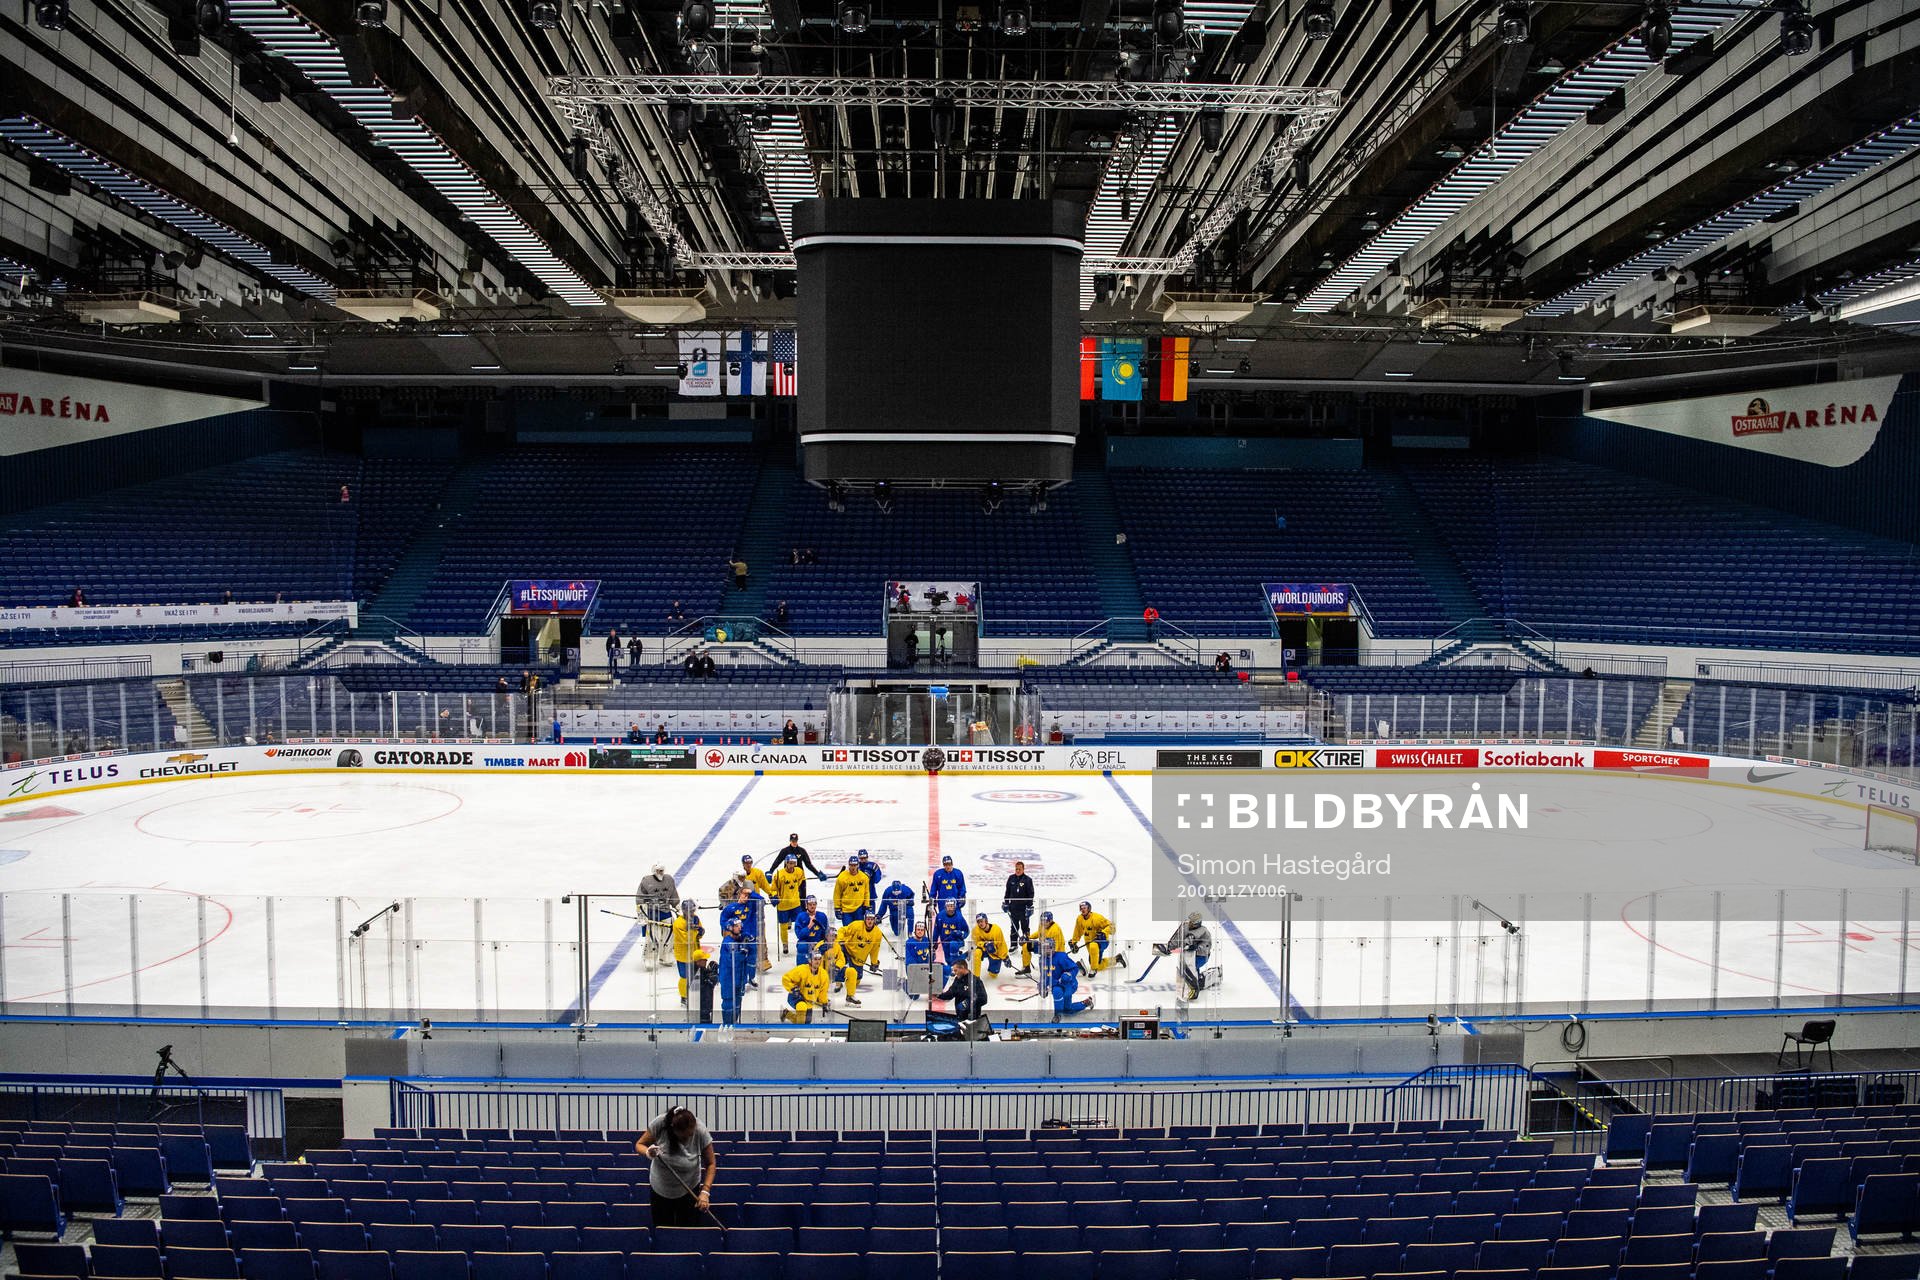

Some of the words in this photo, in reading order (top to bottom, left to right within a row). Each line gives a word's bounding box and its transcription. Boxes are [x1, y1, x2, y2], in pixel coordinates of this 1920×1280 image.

[19, 396, 110, 423] ARÉNA
[1735, 415, 1779, 432] OSTRAVAR
[1786, 403, 1878, 429] ARÉNA
[521, 589, 588, 601] #LETSSHOWOFF
[1271, 592, 1344, 604] #WORLDJUNIORS
[374, 751, 473, 765] GATORADE
[484, 758, 524, 766] TIMBER
[528, 758, 560, 766] MART
[727, 754, 748, 764] AIR
[751, 754, 807, 764] CANADA
[849, 750, 920, 762] TISSOT
[974, 750, 1045, 762] TISSOT
[1097, 751, 1126, 763] BFL
[1275, 751, 1320, 767] OK
[1323, 752, 1361, 766] TIRE
[1484, 751, 1584, 767] Scotiabank
[49, 764, 119, 784] TELUS
[140, 762, 239, 778] CHEVROLET
[1857, 784, 1910, 808] TELUS
